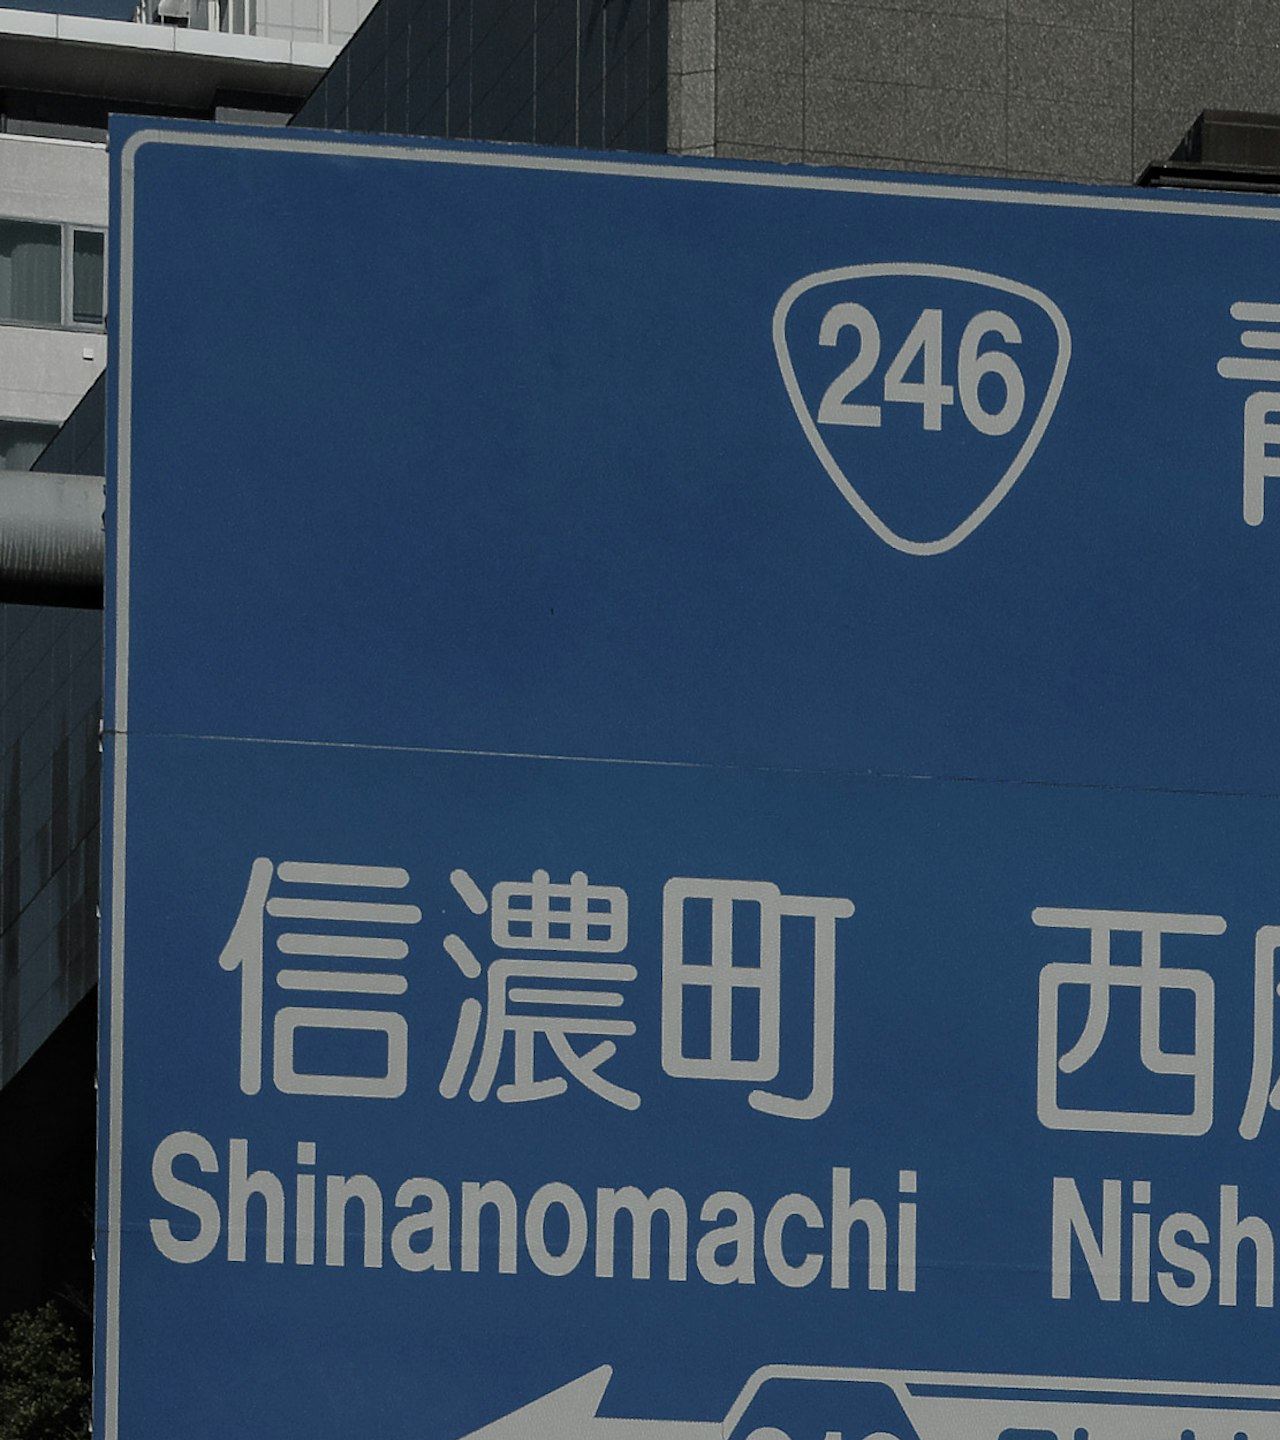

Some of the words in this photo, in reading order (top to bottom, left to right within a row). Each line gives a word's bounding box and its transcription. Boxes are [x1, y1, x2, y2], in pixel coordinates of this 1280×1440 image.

[817, 302, 1026, 436] 246
[219, 858, 855, 1119] 信濃町
[150, 1131, 916, 1291] Shinanomachi
